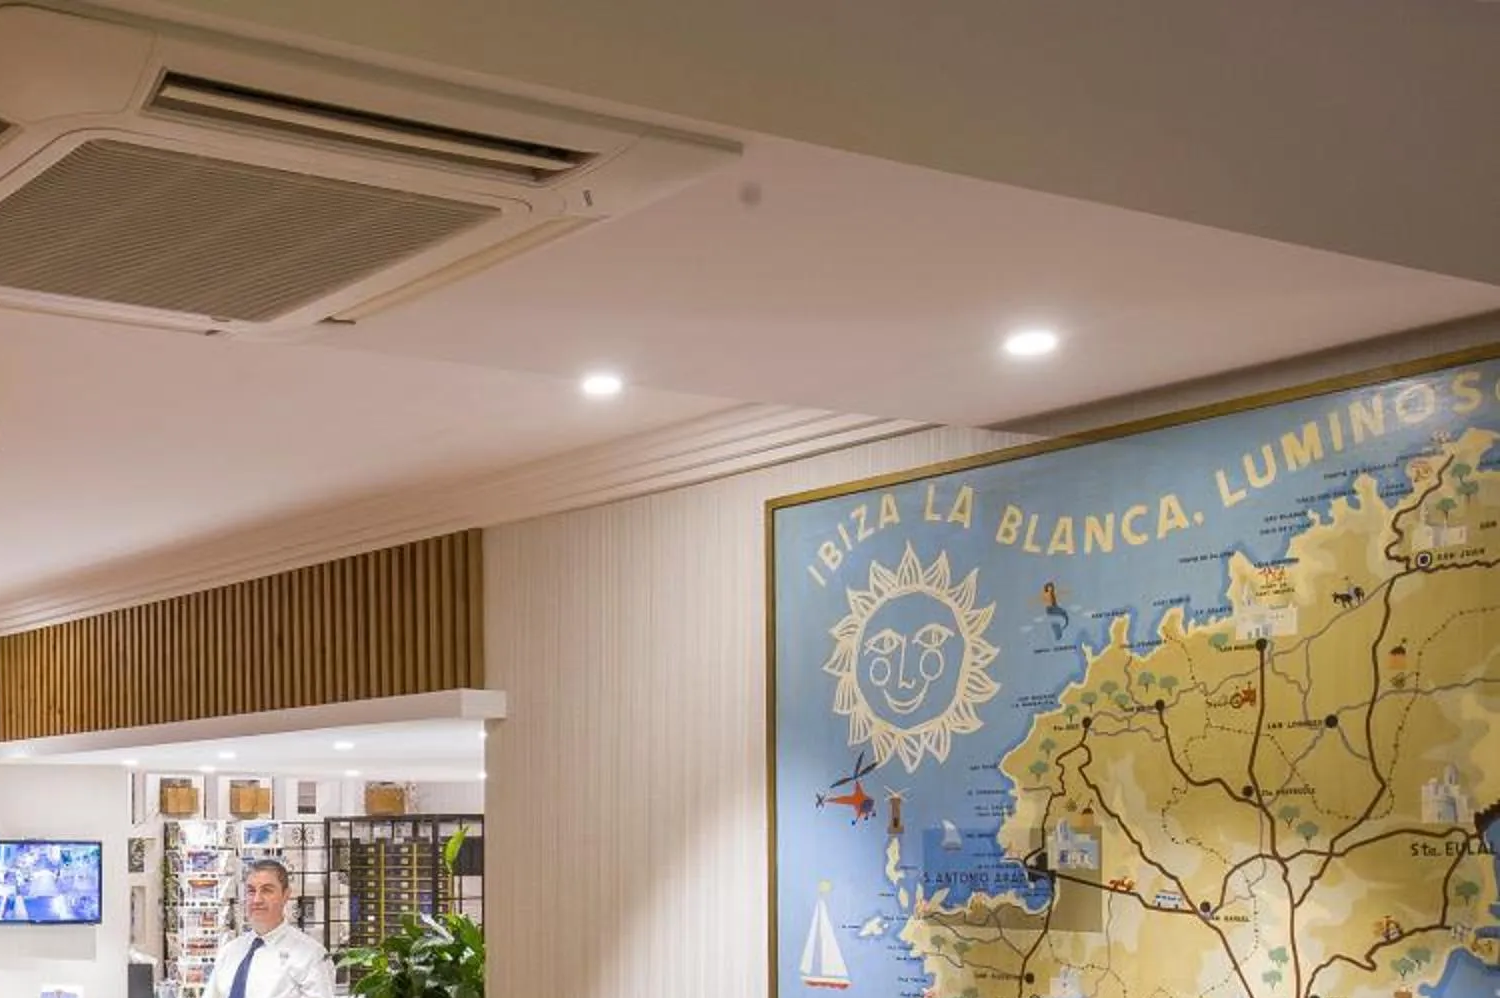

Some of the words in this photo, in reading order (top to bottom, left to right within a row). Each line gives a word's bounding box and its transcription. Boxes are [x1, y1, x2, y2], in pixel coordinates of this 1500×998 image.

[807, 493, 900, 587] IBIZA
[923, 484, 974, 529] LA
[996, 494, 1205, 555] BLANCA.
[1215, 370, 1500, 507] LUMINOS
